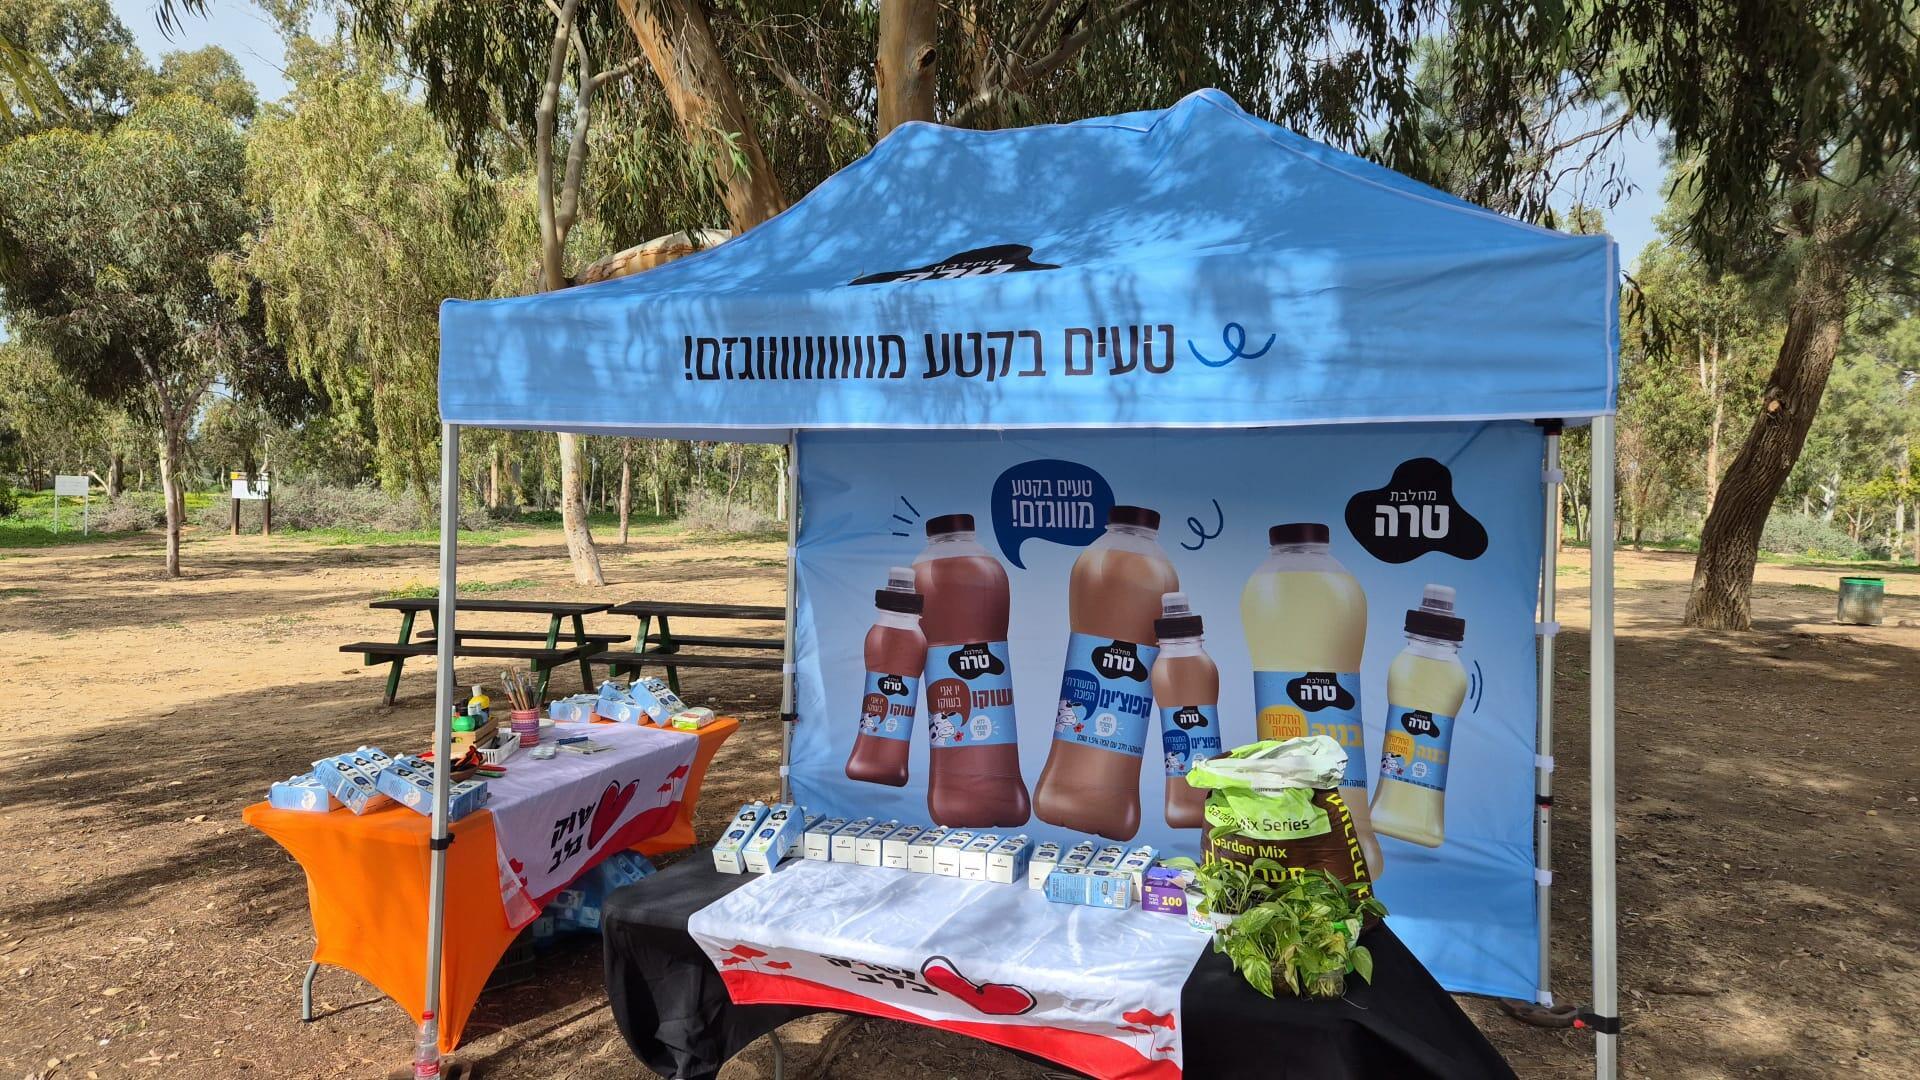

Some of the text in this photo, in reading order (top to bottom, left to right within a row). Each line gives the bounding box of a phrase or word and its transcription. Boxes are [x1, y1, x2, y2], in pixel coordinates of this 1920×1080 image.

[922, 329, 1047, 382] בקטע
[1064, 324, 1174, 376] טעים
[1011, 479, 1093, 499] טעים בקטע
[1390, 489, 1438, 502] מחלבת
[1011, 499, 1095, 529] מוווגזם!
[1374, 504, 1450, 539] טרה
[960, 655, 990, 670] טרה
[1102, 653, 1135, 672] טרה
[883, 681, 902, 691] טרה
[1300, 684, 1337, 701] טרה
[971, 687, 1014, 710] שוקו
[1098, 688, 1154, 719] קפוצ'ינו
[1180, 713, 1199, 724] טרה
[1408, 717, 1431, 731] טרה
[1262, 818, 1310, 832] Series
[1258, 845, 1287, 858] Mix
[1161, 896, 1183, 907] 100
